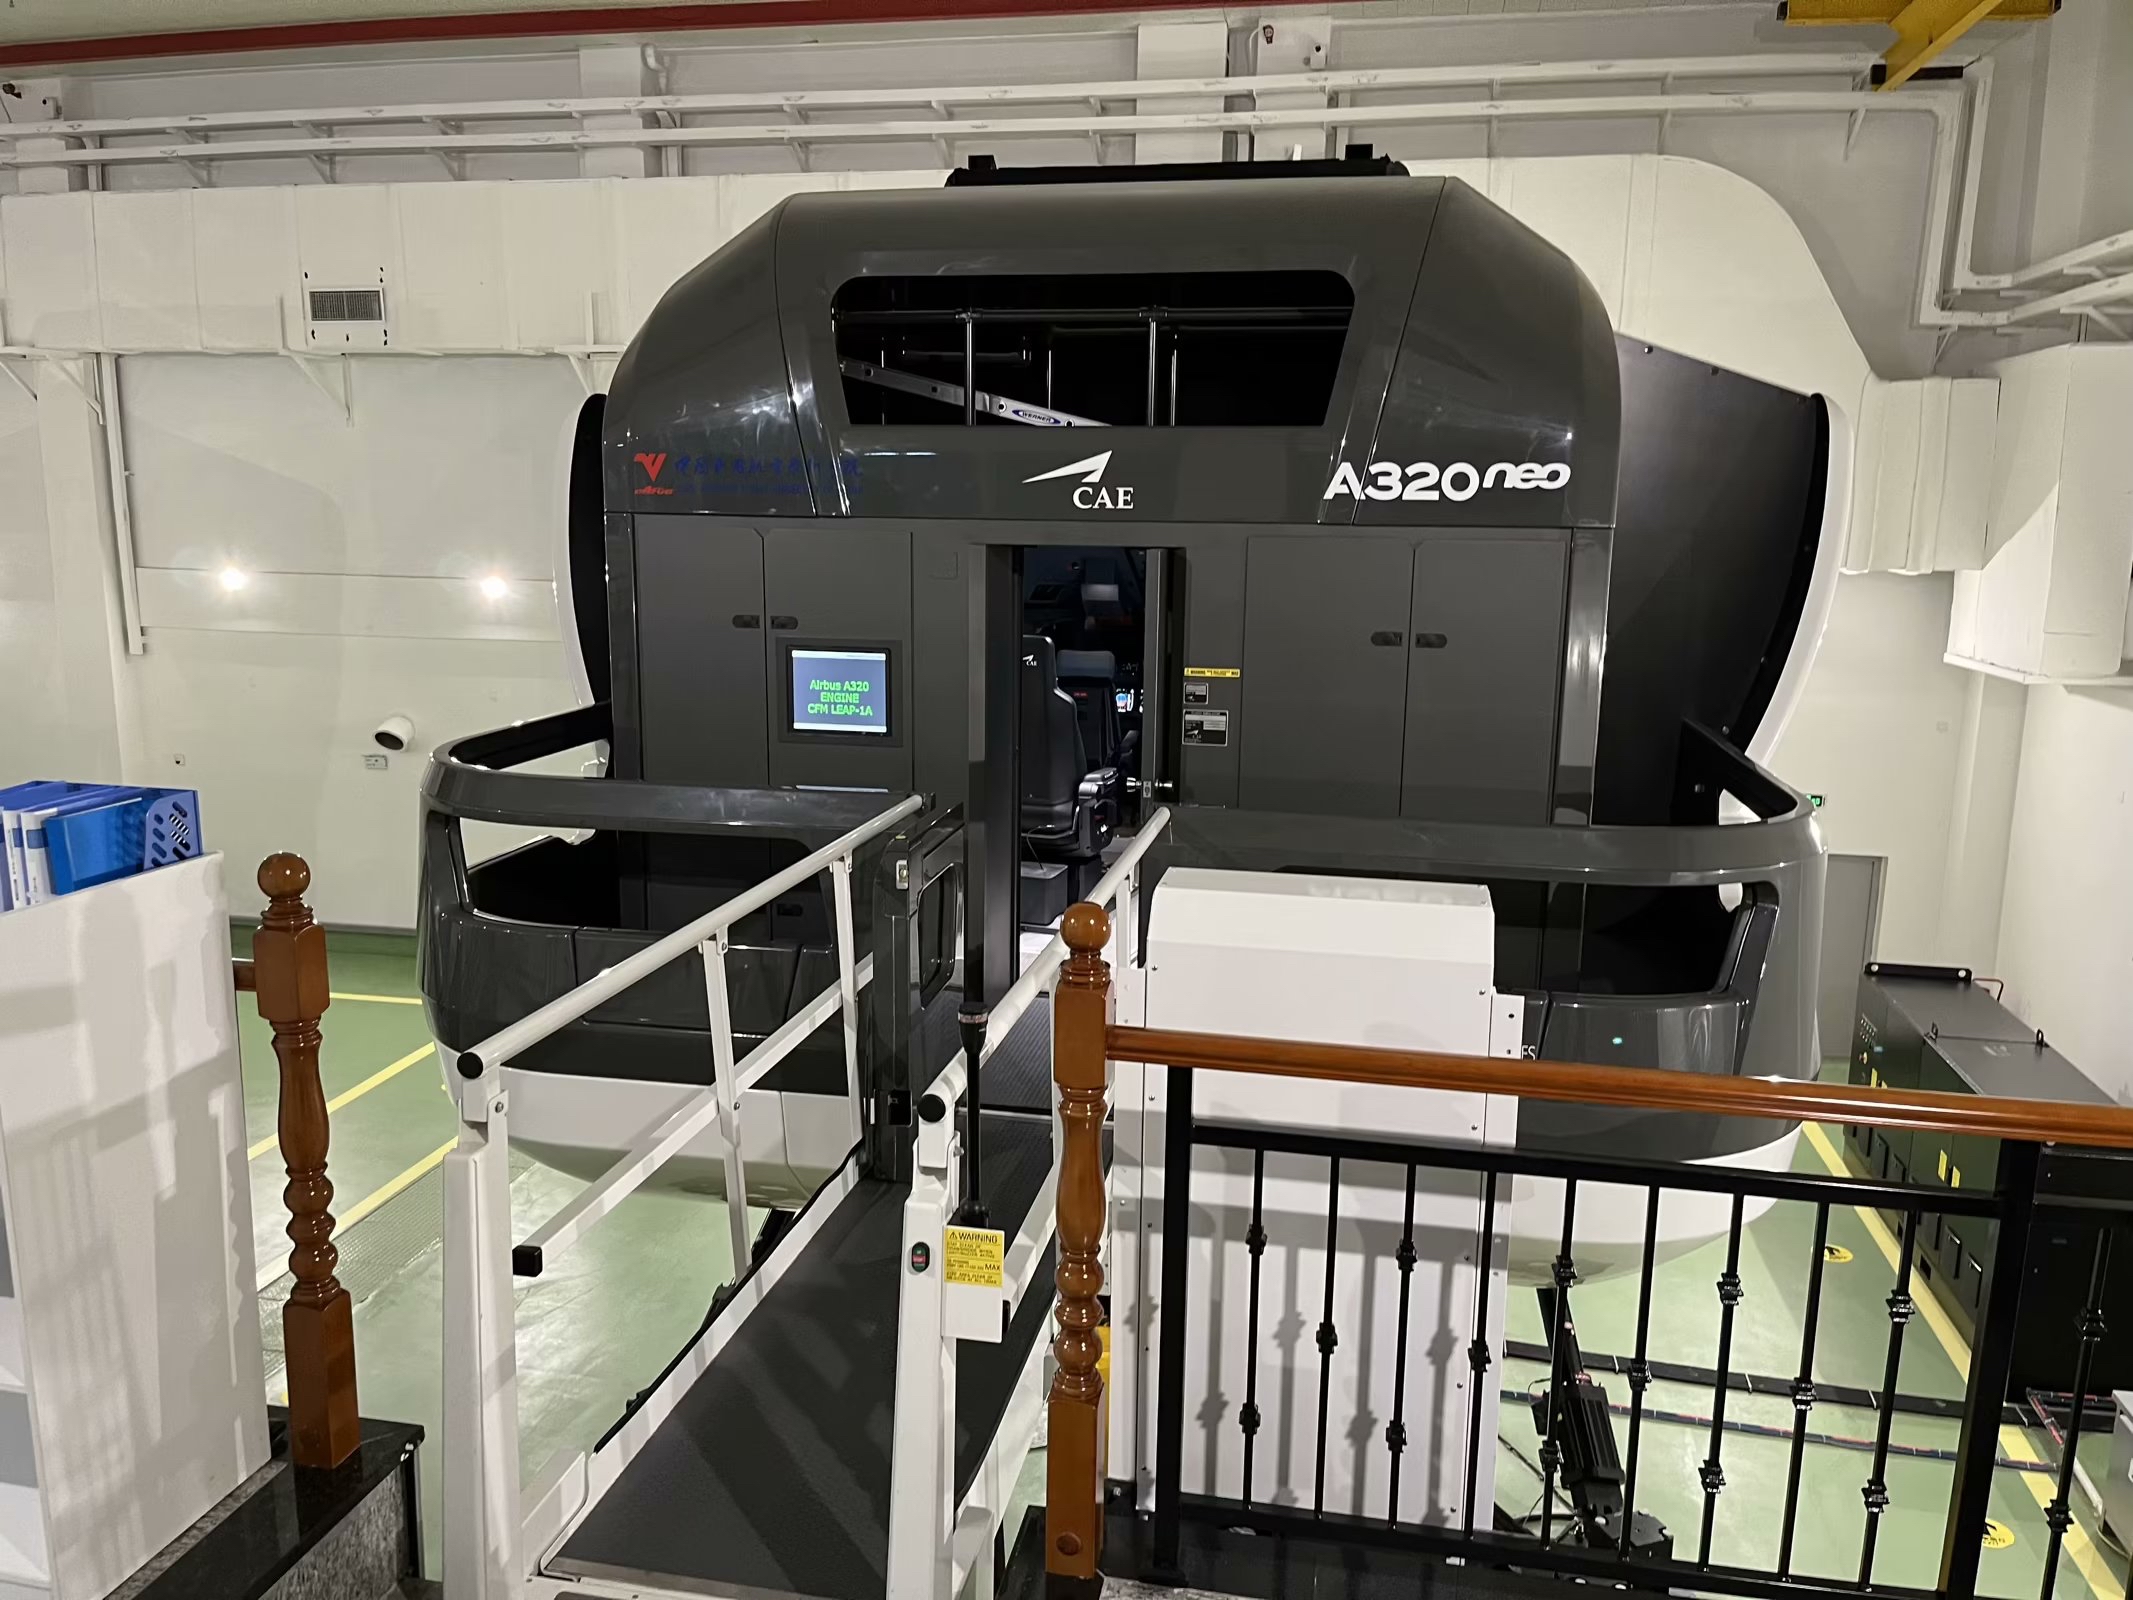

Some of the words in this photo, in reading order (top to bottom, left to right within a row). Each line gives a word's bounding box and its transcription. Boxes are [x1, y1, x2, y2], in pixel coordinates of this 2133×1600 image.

[1022, 411, 1051, 422] WERNER
[1072, 486, 1134, 509] CAE
[809, 680, 841, 690] Airbus
[843, 681, 869, 692] A320
[820, 692, 860, 703] ENGINE
[808, 703, 828, 714] CFM
[831, 704, 873, 716] LEAP-1A
[958, 1232, 998, 1244] WARNING
[985, 1263, 1001, 1271] MAX
